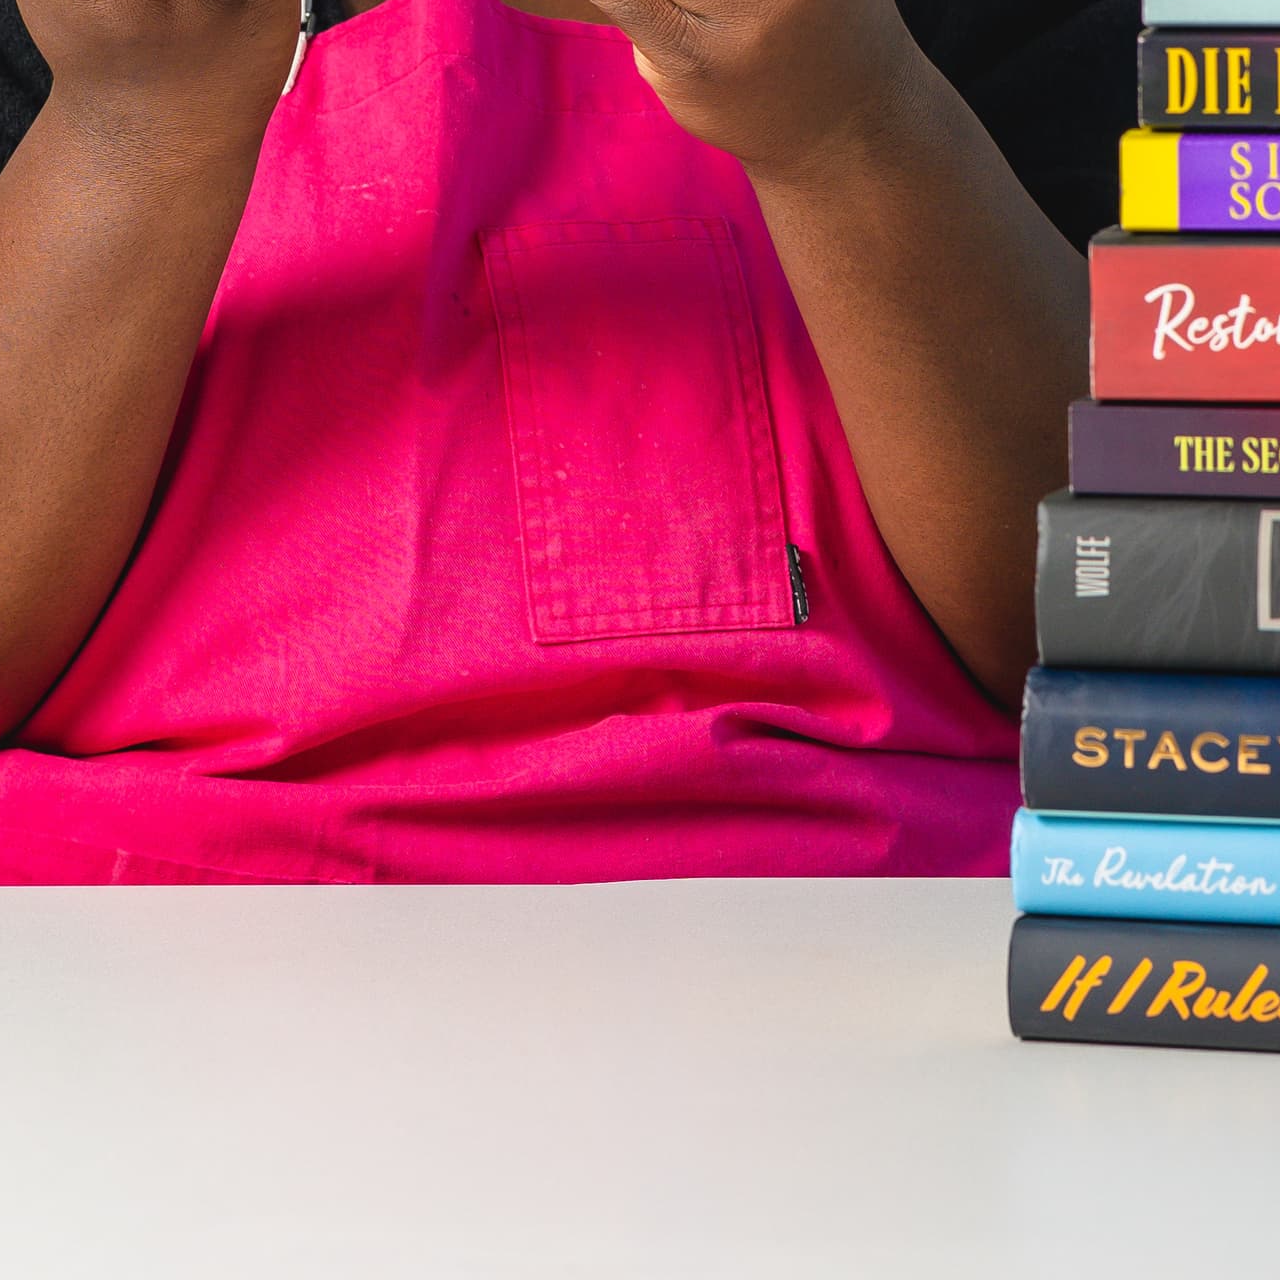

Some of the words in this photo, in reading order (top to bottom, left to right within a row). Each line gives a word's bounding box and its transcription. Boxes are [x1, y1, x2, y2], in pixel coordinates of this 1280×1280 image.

[1164, 47, 1252, 116] DIE
[1174, 436, 1234, 472] THE
[1074, 536, 1110, 598] WOLFE
[1040, 856, 1084, 888] The
[1093, 846, 1276, 897] Revelation
[1042, 954, 1113, 1020] If
[1108, 957, 1152, 1014] I
